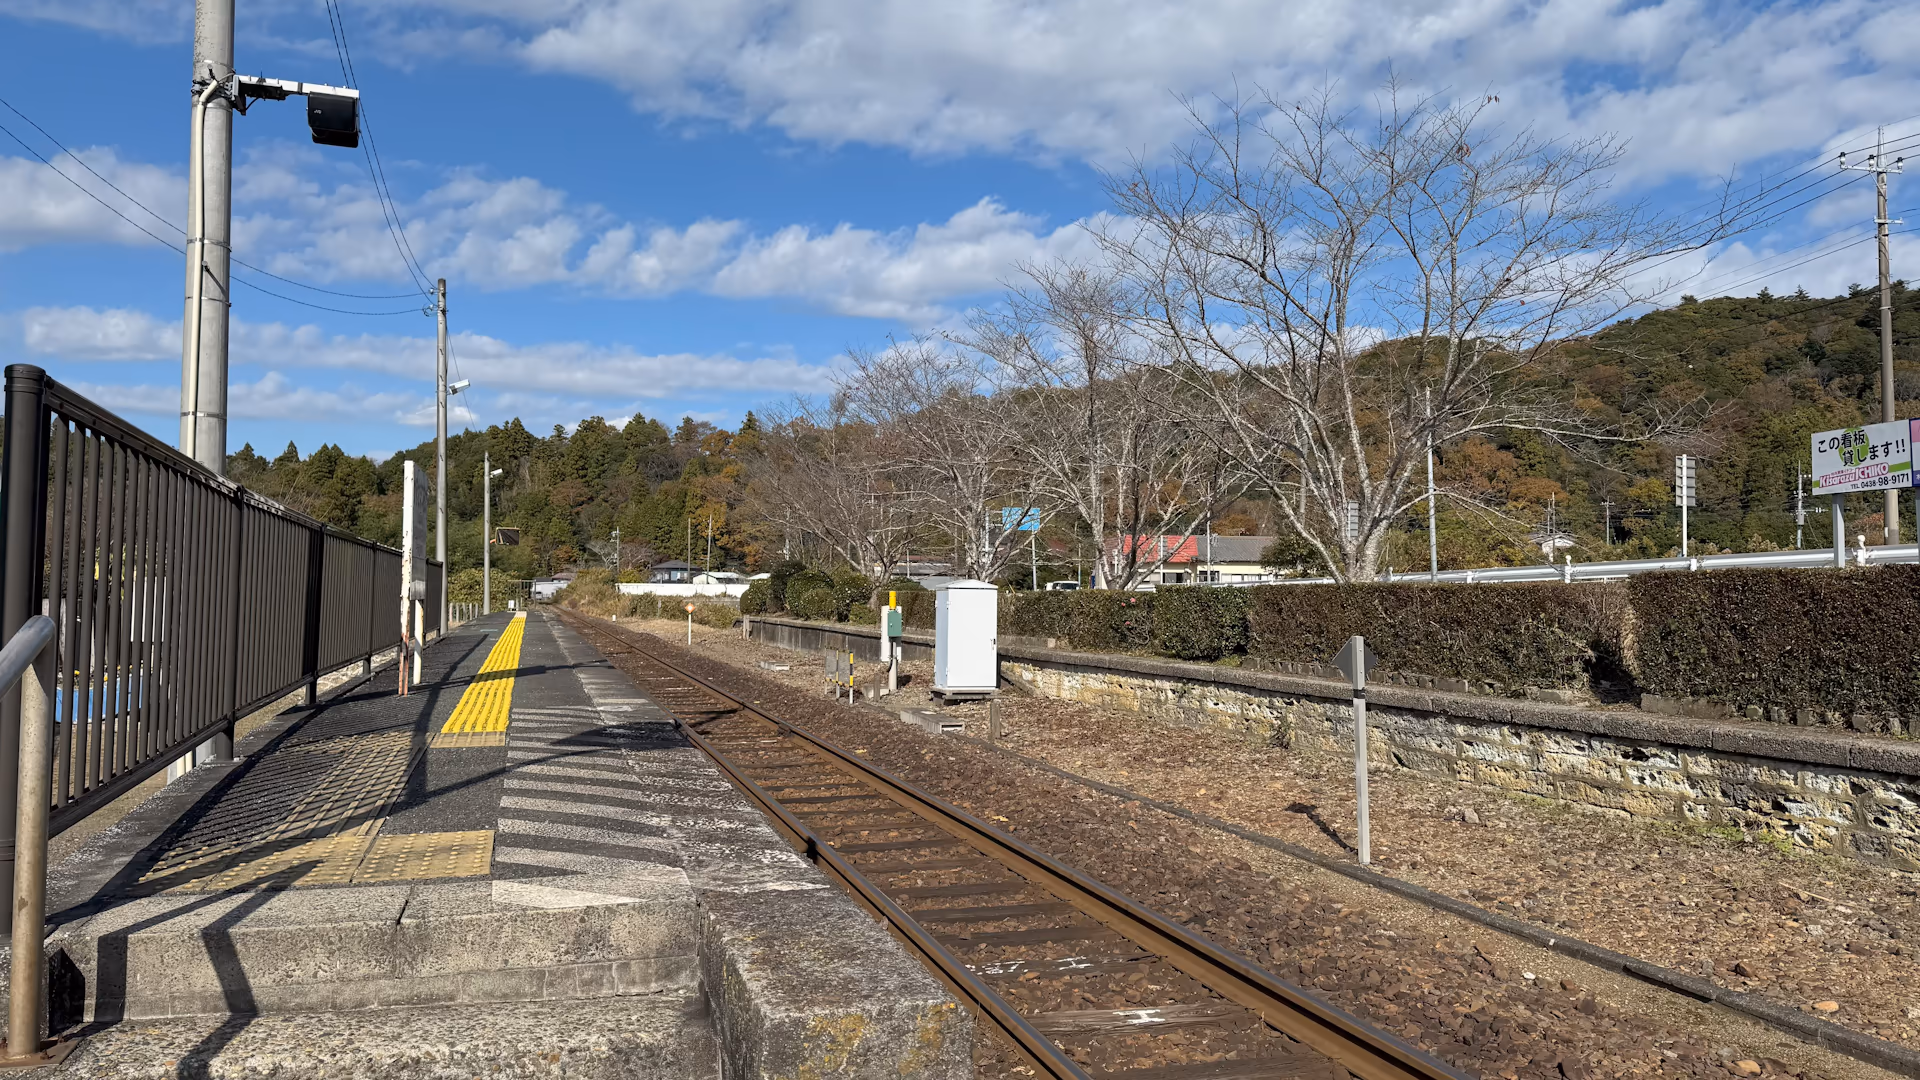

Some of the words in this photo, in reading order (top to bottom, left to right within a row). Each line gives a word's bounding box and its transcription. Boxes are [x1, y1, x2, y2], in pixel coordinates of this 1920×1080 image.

[1818, 429, 1865, 453] この看板
[1855, 462, 1889, 480] ICHIKO
[1860, 473, 1909, 489] 0438-98-9171
